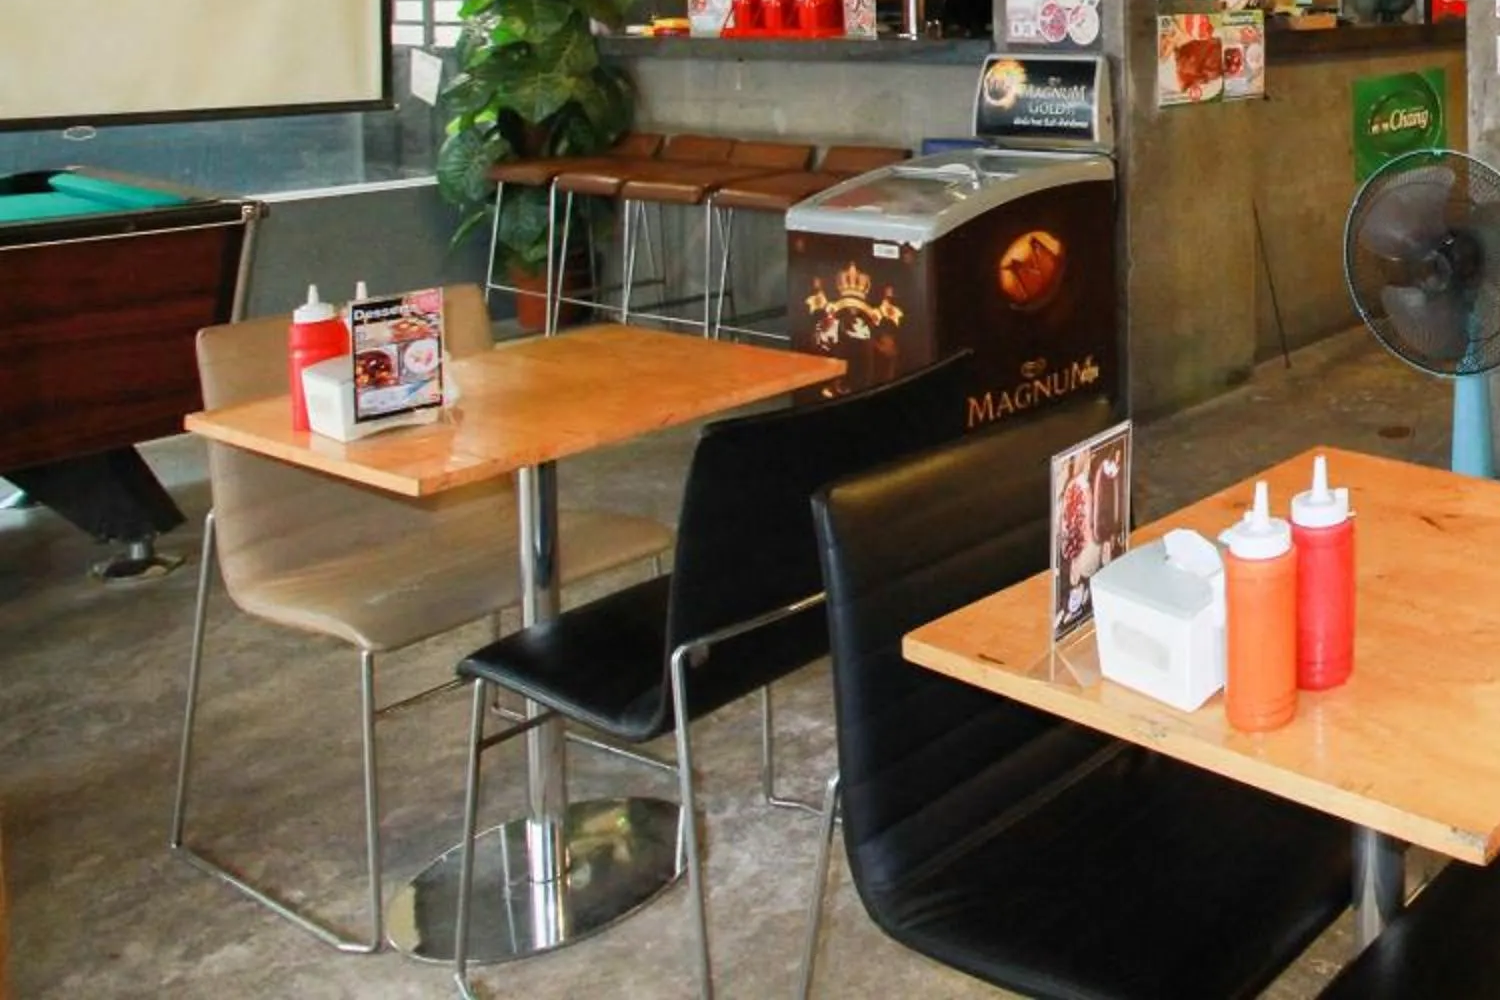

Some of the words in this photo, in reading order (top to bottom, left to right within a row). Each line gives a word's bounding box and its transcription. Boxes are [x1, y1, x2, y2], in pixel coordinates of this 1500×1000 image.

[1020, 84, 1087, 101] MAGNUM
[1389, 107, 1429, 131] Chang
[966, 361, 1095, 427] MAGNUM
